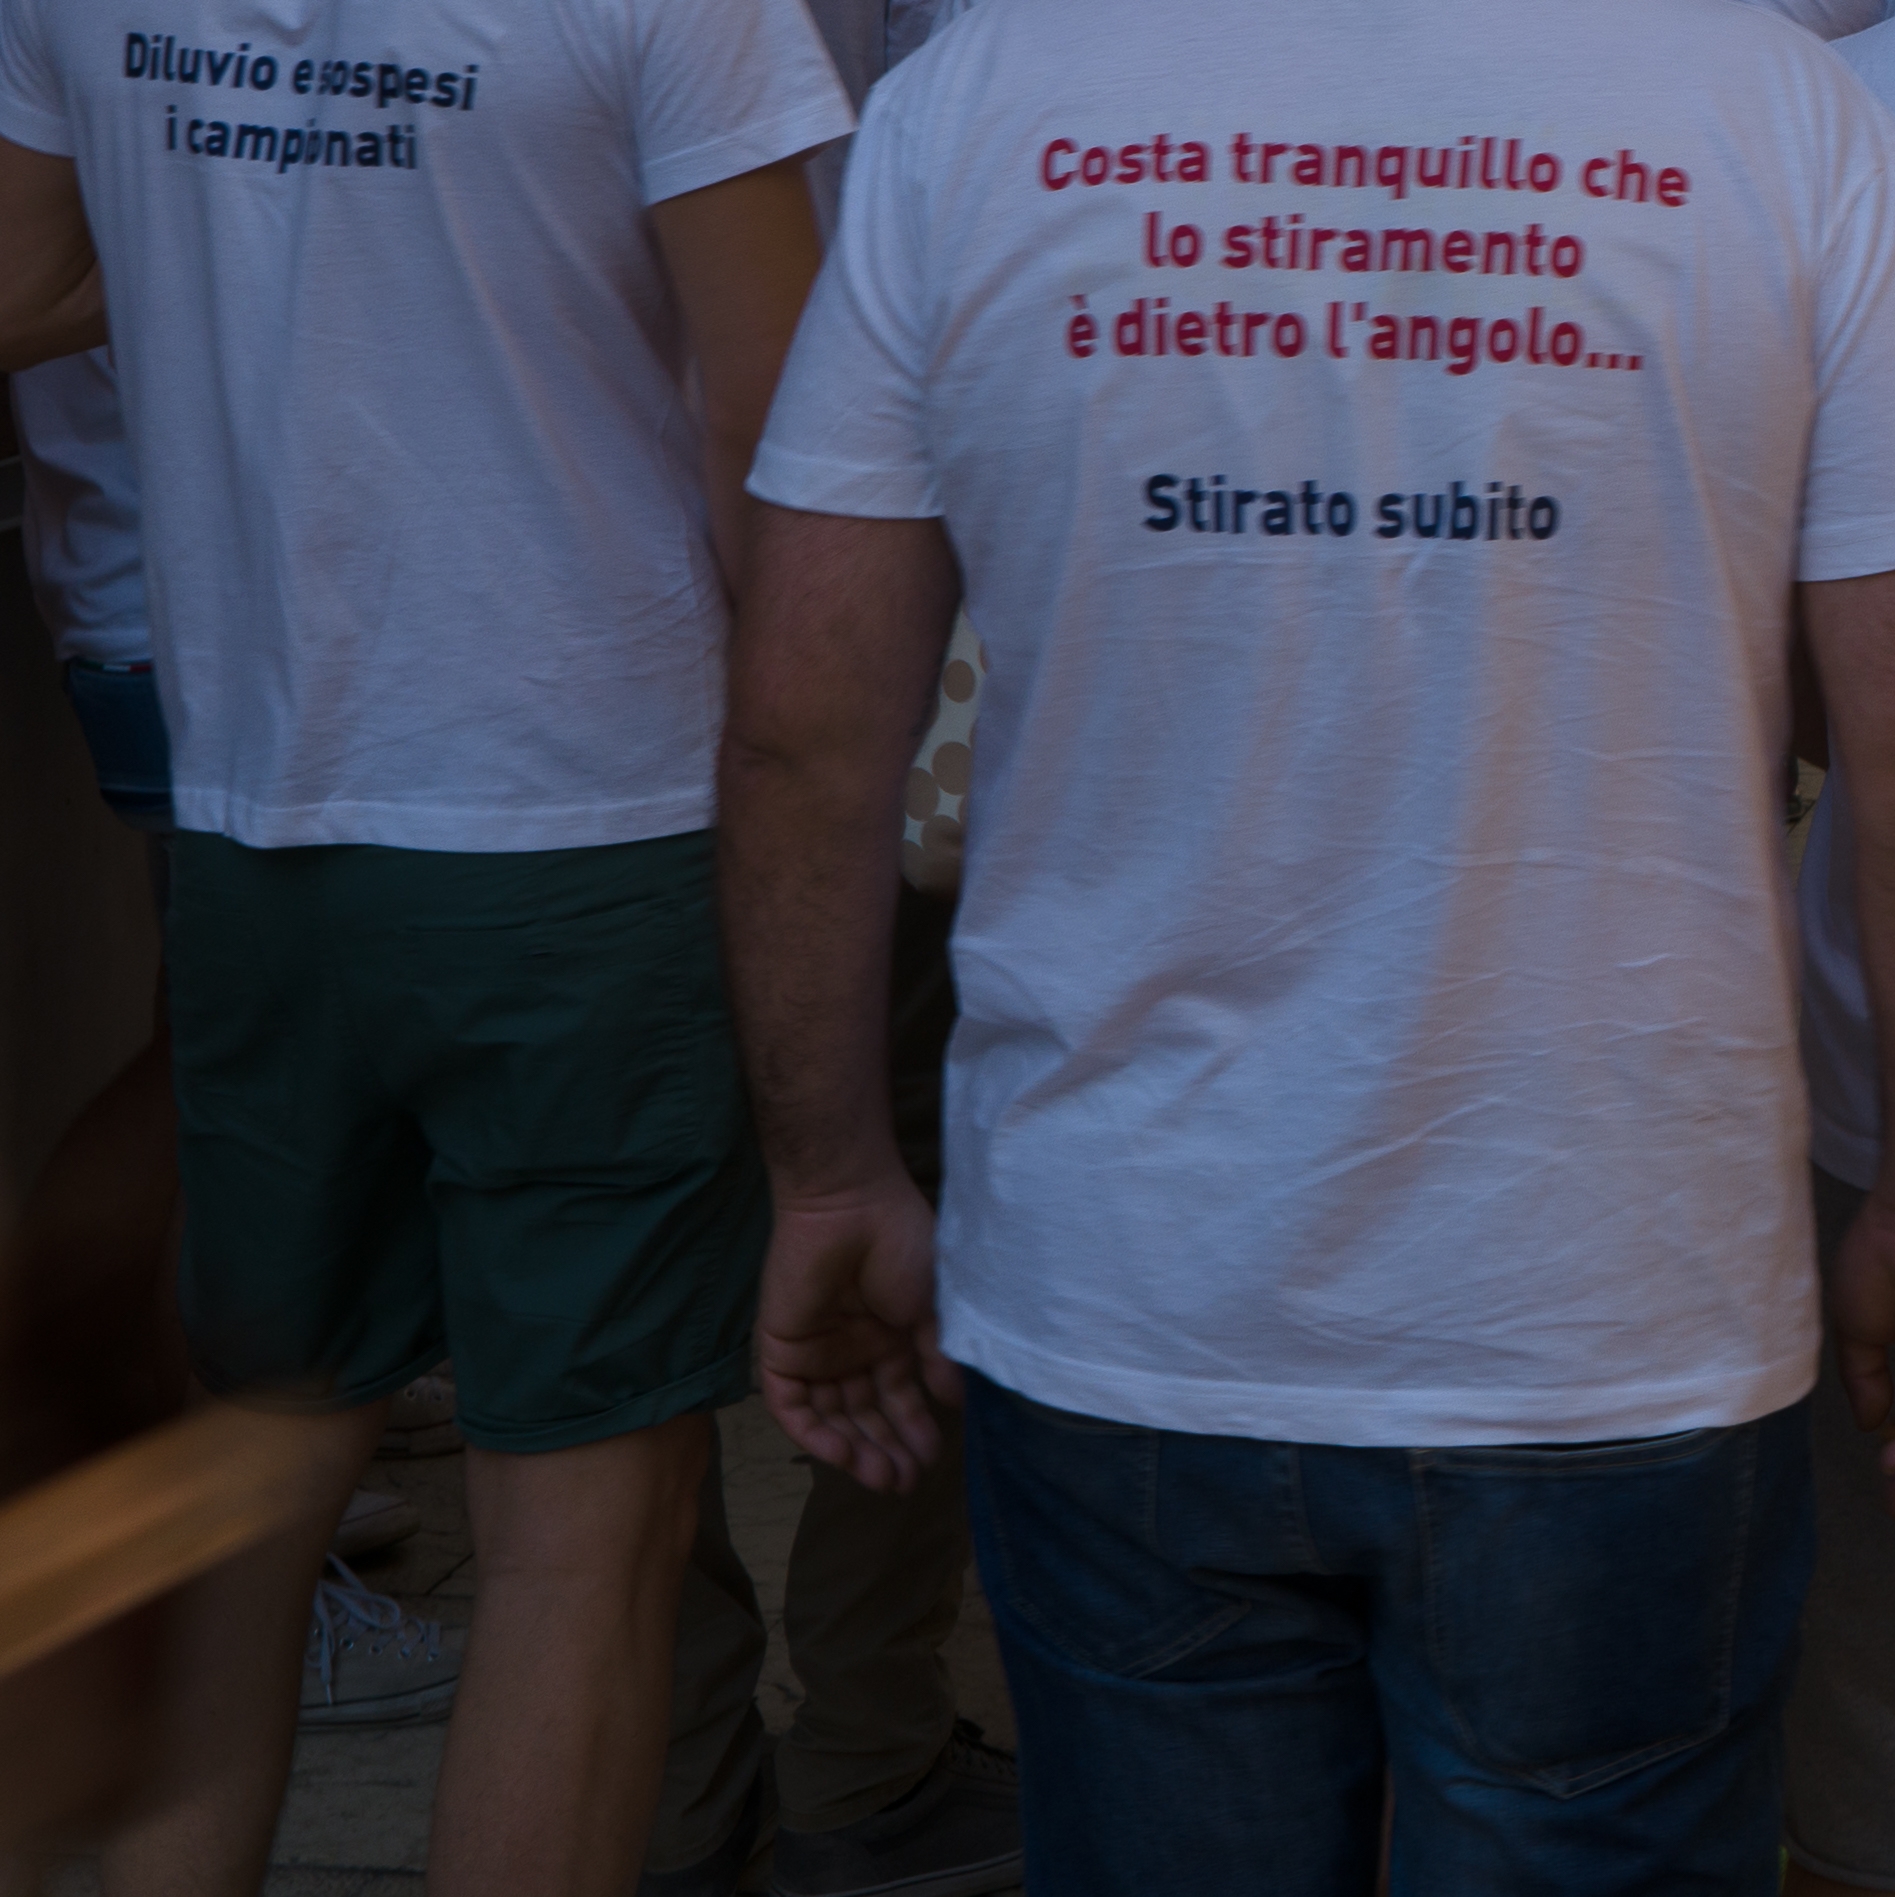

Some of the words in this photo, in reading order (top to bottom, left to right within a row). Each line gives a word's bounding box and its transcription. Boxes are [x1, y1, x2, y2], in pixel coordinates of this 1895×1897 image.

[124, 31, 279, 91] Diluvio
[293, 59, 315, 95] e
[166, 104, 178, 151] i
[1040, 132, 1213, 192] Costa
[1229, 131, 1566, 201] tranquillo
[1579, 148, 1692, 208] che
[1143, 210, 1204, 269] lo
[1220, 212, 1587, 278] stiramento
[1066, 292, 1101, 358] è
[1114, 295, 1307, 358] dietro
[1324, 300, 1646, 377] l'angolo...
[1141, 471, 1360, 537] Stirato
[1371, 478, 1564, 541] subito
